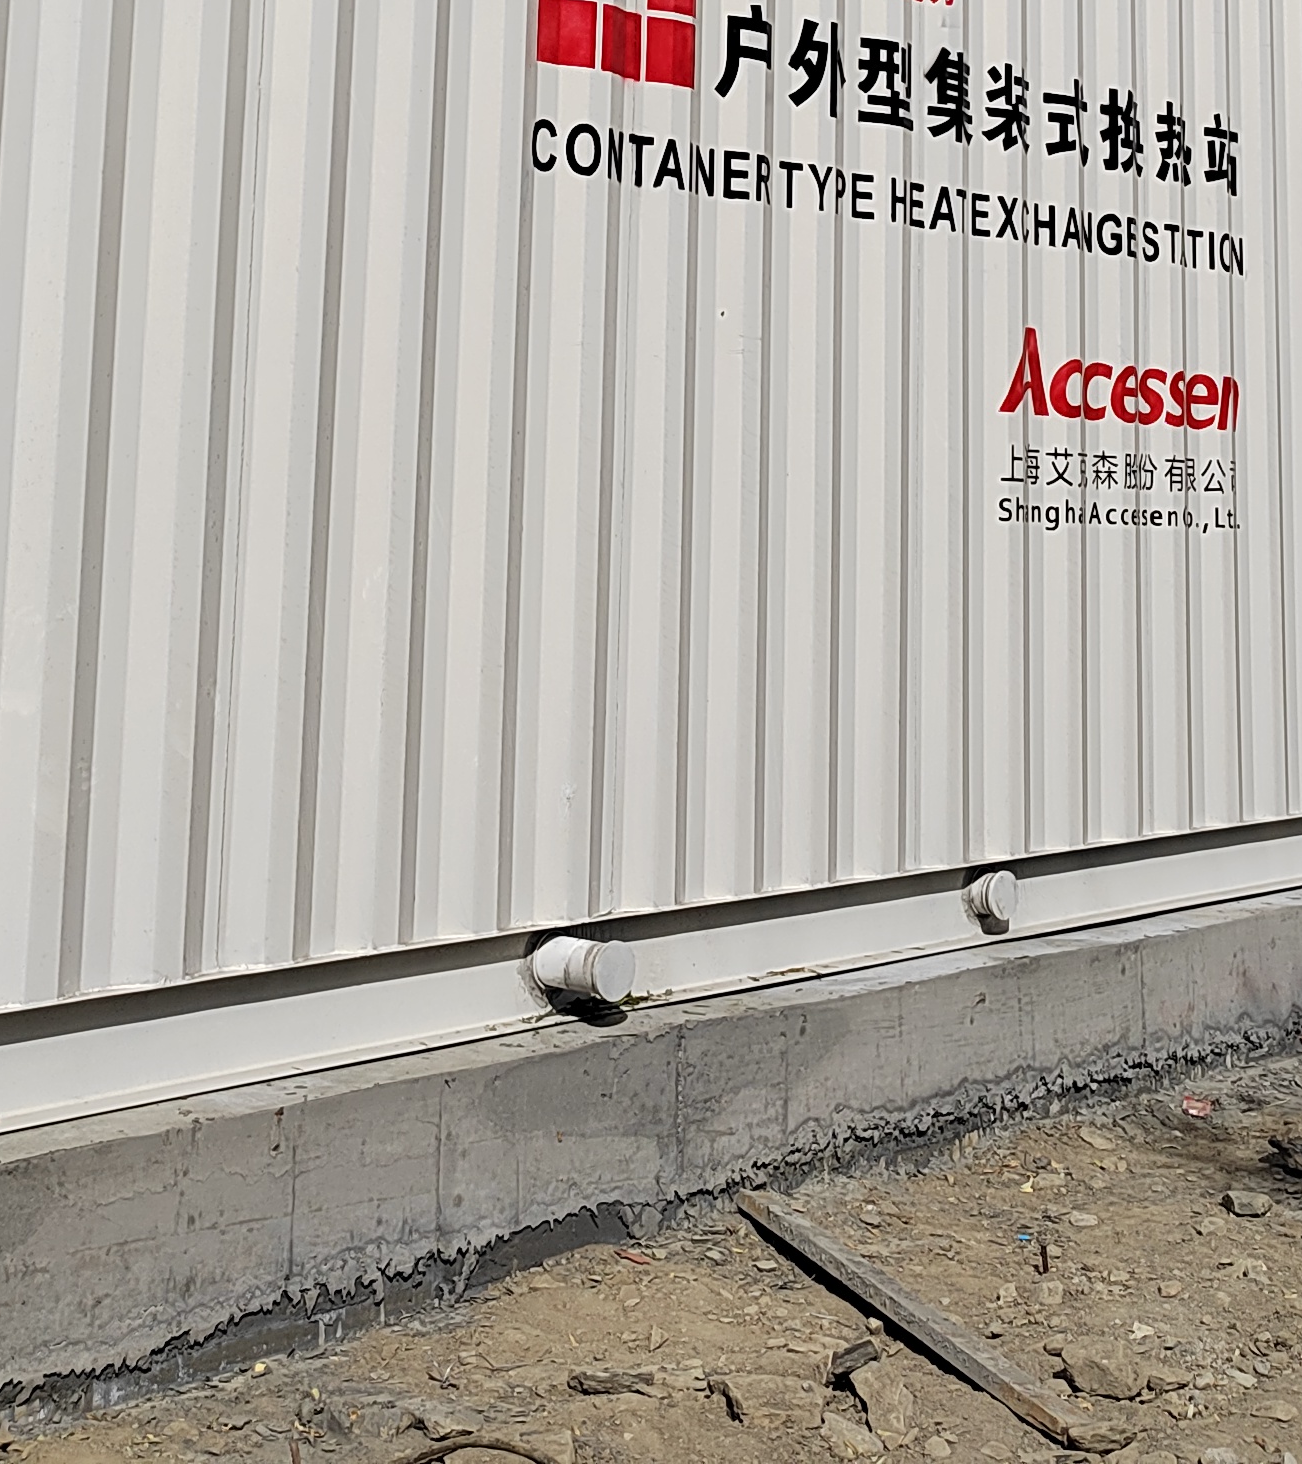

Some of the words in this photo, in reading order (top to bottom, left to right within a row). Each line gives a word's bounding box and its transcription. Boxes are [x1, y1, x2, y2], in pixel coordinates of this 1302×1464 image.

[714, 4, 1239, 197] 户外型集装式换热站
[778, 160, 875, 220] TYPE
[890, 177, 967, 234] HEAT
[998, 326, 1240, 432] Accessen
